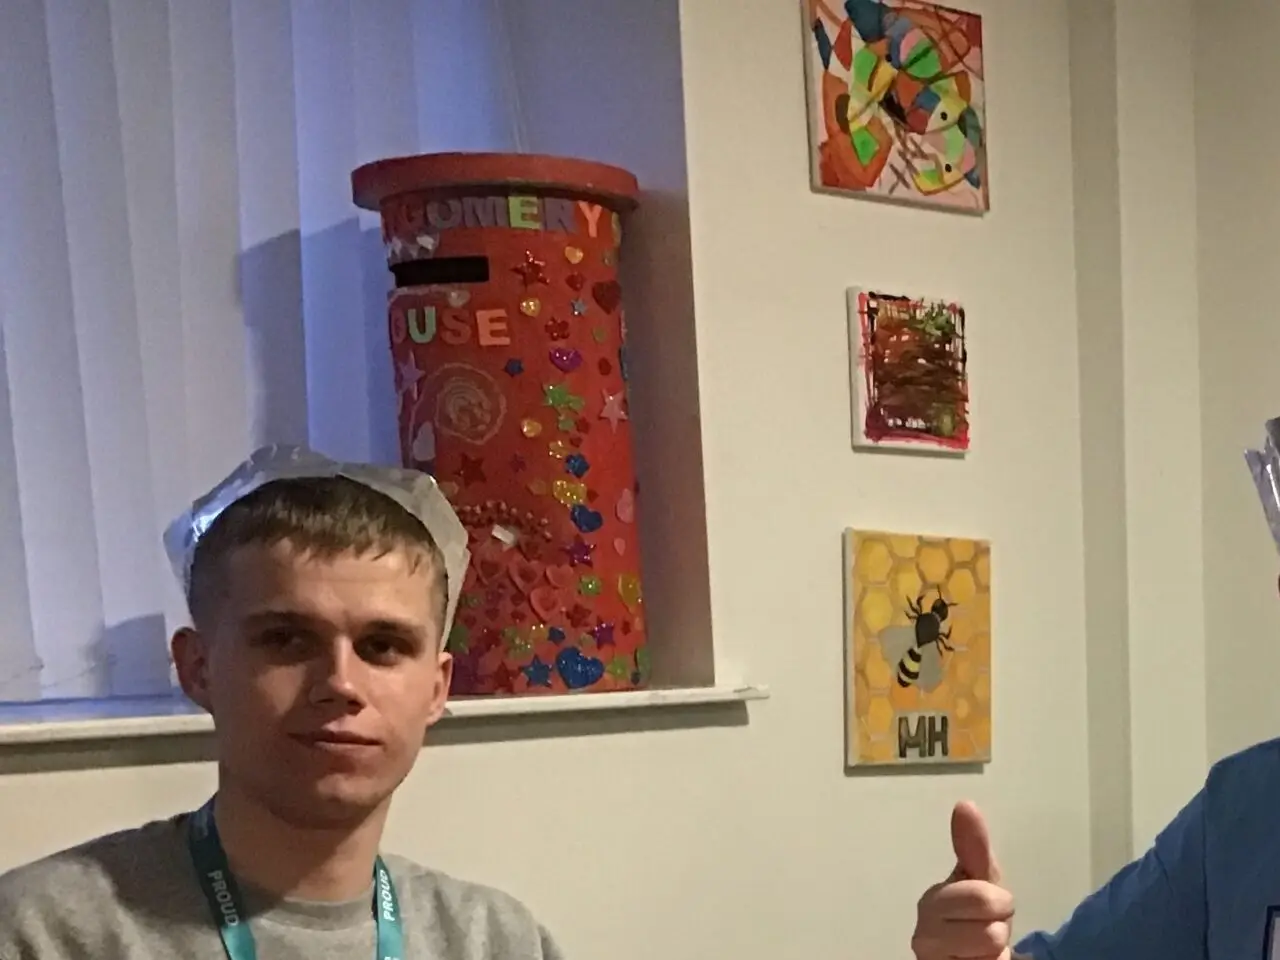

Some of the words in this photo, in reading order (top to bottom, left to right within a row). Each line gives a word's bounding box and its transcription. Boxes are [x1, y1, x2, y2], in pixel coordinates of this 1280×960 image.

[897, 714, 949, 758] MH
[207, 869, 240, 927] PROUD
[379, 869, 396, 922] PROUD
